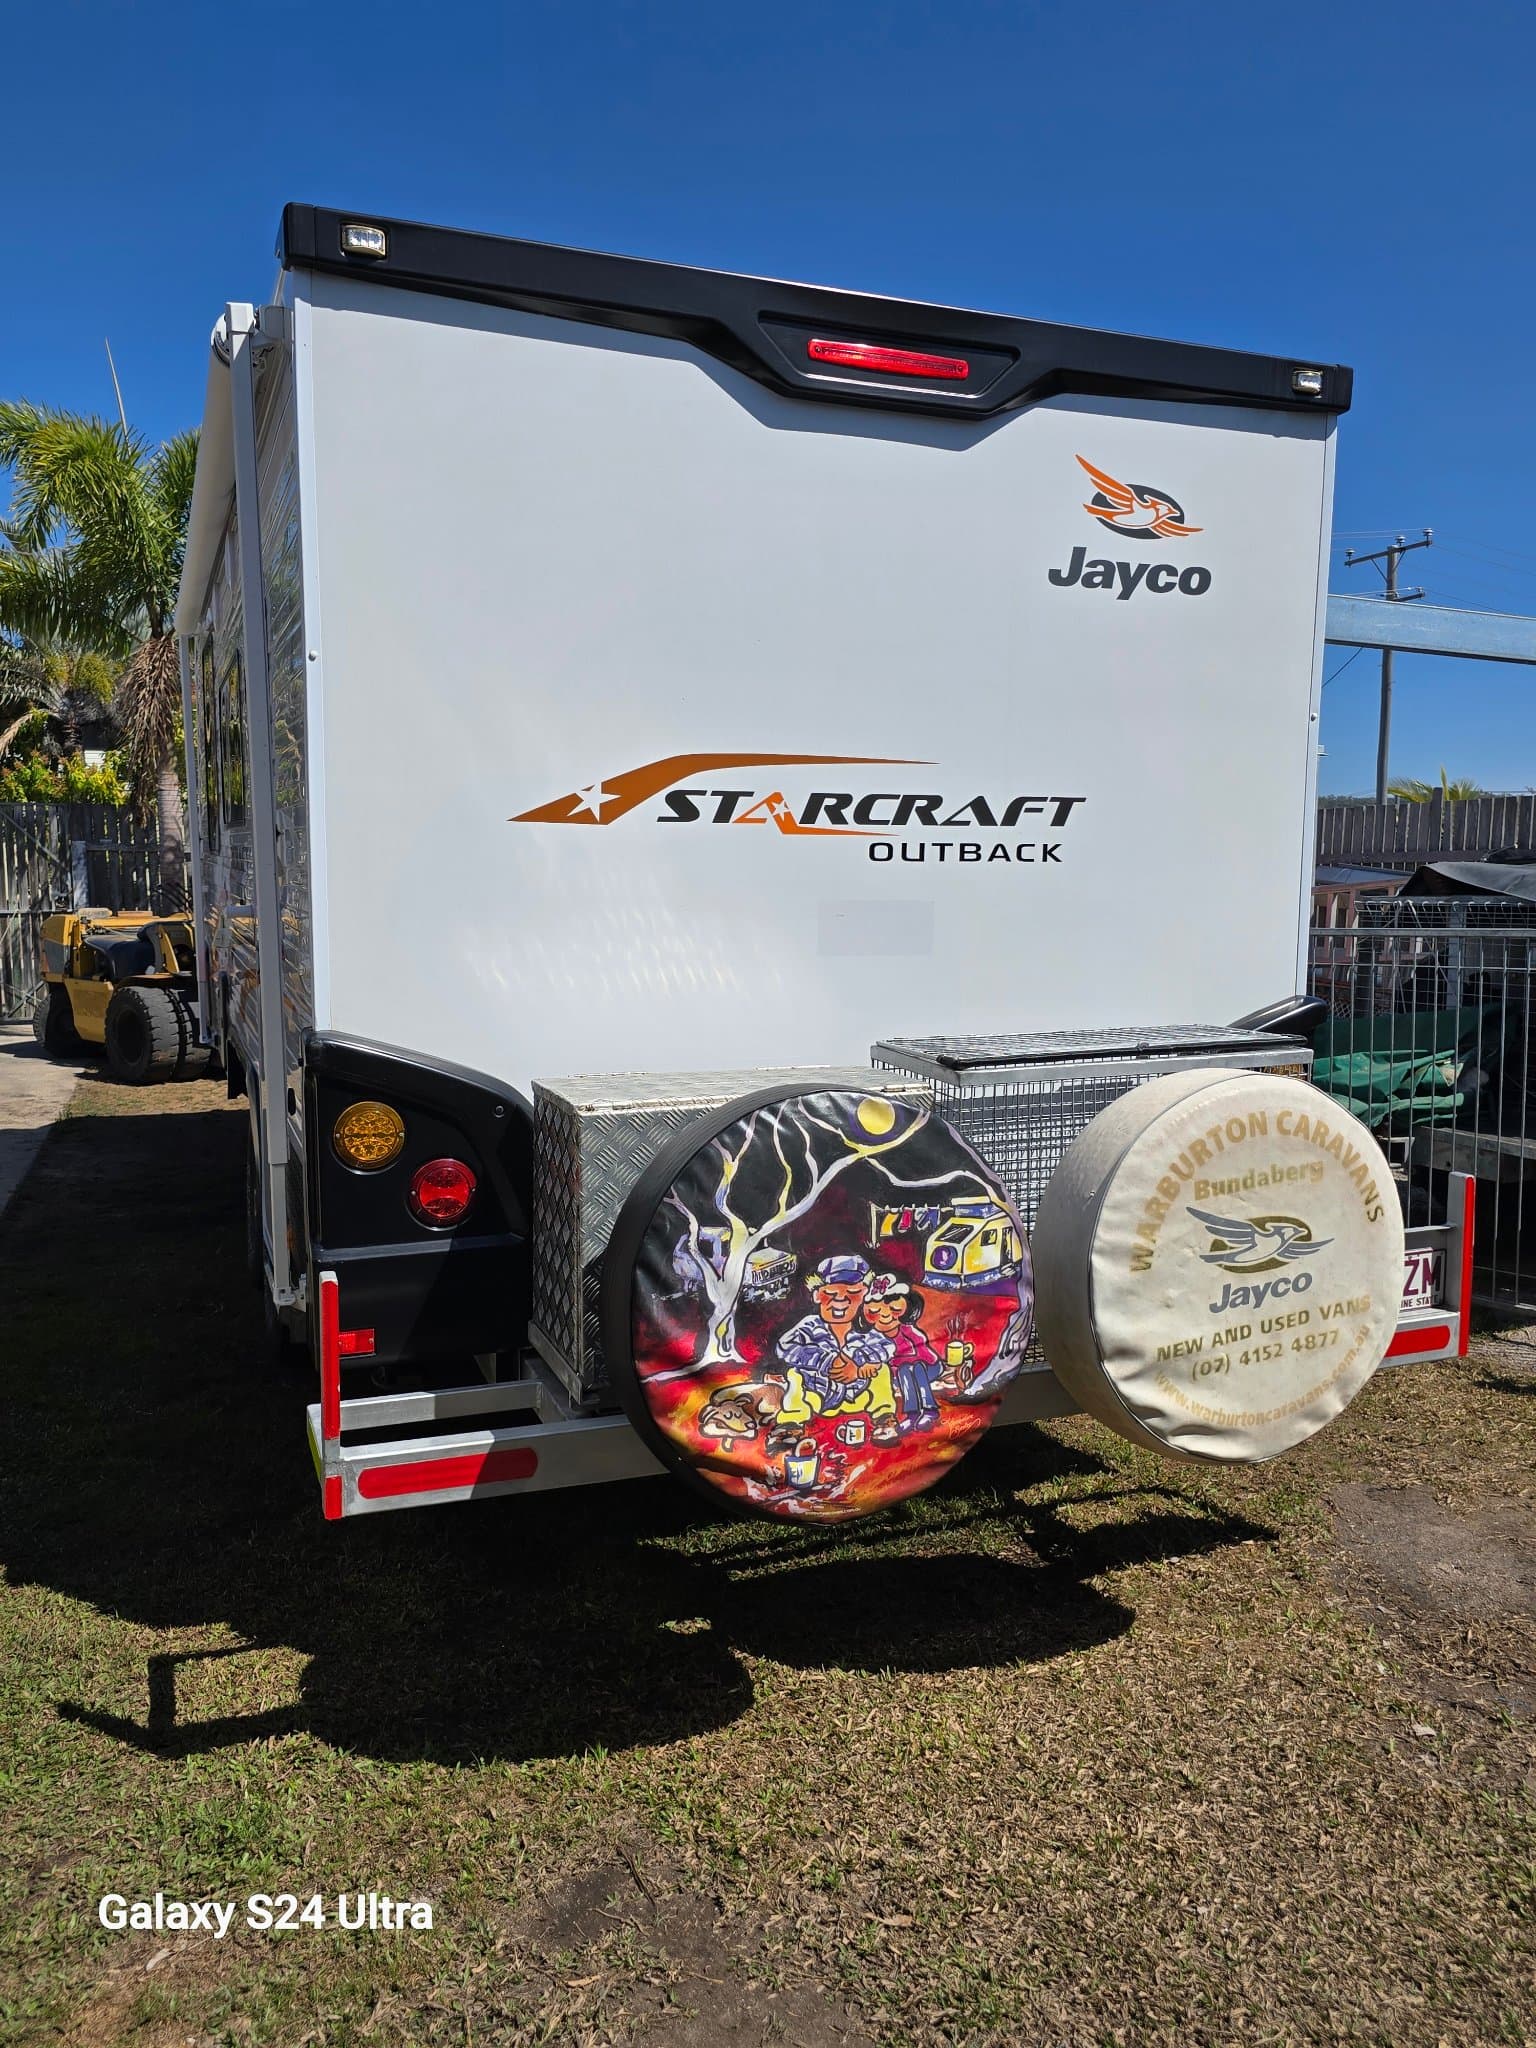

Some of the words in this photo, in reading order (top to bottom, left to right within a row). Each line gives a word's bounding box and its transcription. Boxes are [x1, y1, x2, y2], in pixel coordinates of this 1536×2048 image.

[1048, 546, 1212, 601] Jayco
[656, 789, 1088, 836] STARCRAFT
[868, 841, 1064, 863] OUTBACK
[1130, 1110, 1268, 1273] WARBURTON
[1276, 1110, 1384, 1223] CARAVANS
[1193, 1160, 1324, 1201] Bundaberg
[1209, 1272, 1313, 1314] Jayco
[1156, 1336, 1204, 1362] NEW
[1211, 1324, 1252, 1349] AND
[1260, 1310, 1310, 1334] USED
[1319, 1295, 1371, 1321] VANS
[1191, 1353, 1230, 1381] (07)
[1239, 1344, 1283, 1366] 4152
[1291, 1328, 1341, 1353] 4877
[1155, 1324, 1370, 1427] www.warburtoncaravans.com.au
